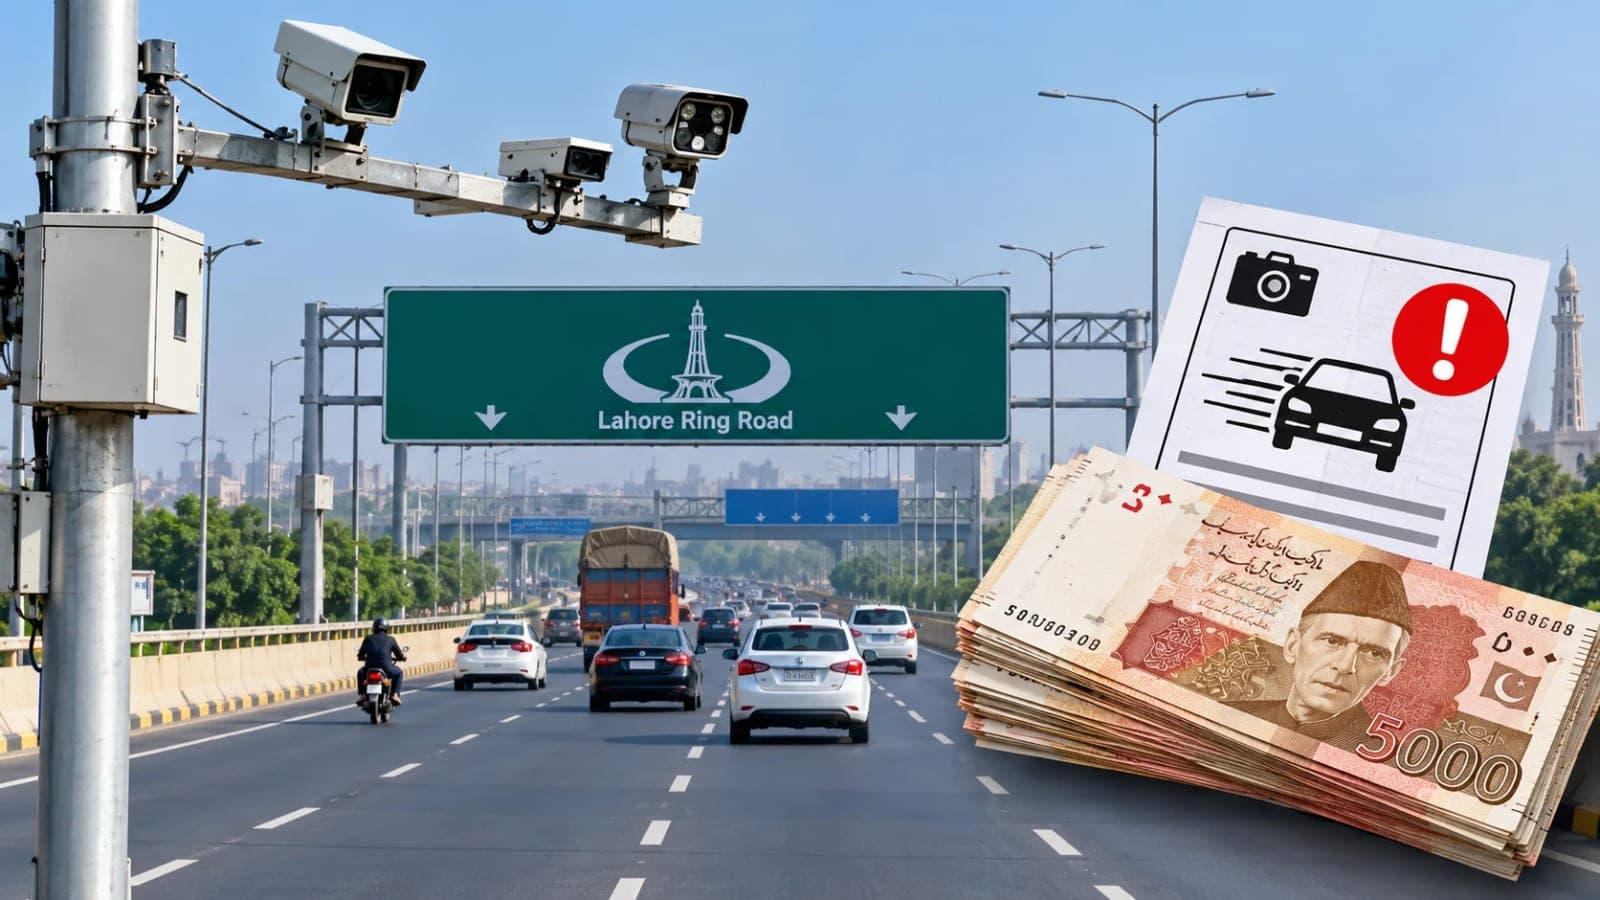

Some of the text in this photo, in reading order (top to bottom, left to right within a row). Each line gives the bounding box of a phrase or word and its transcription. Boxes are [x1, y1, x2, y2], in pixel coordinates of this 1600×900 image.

[598, 410, 793, 434] Lahore Ring Road
[1356, 712, 1522, 805] 5000
